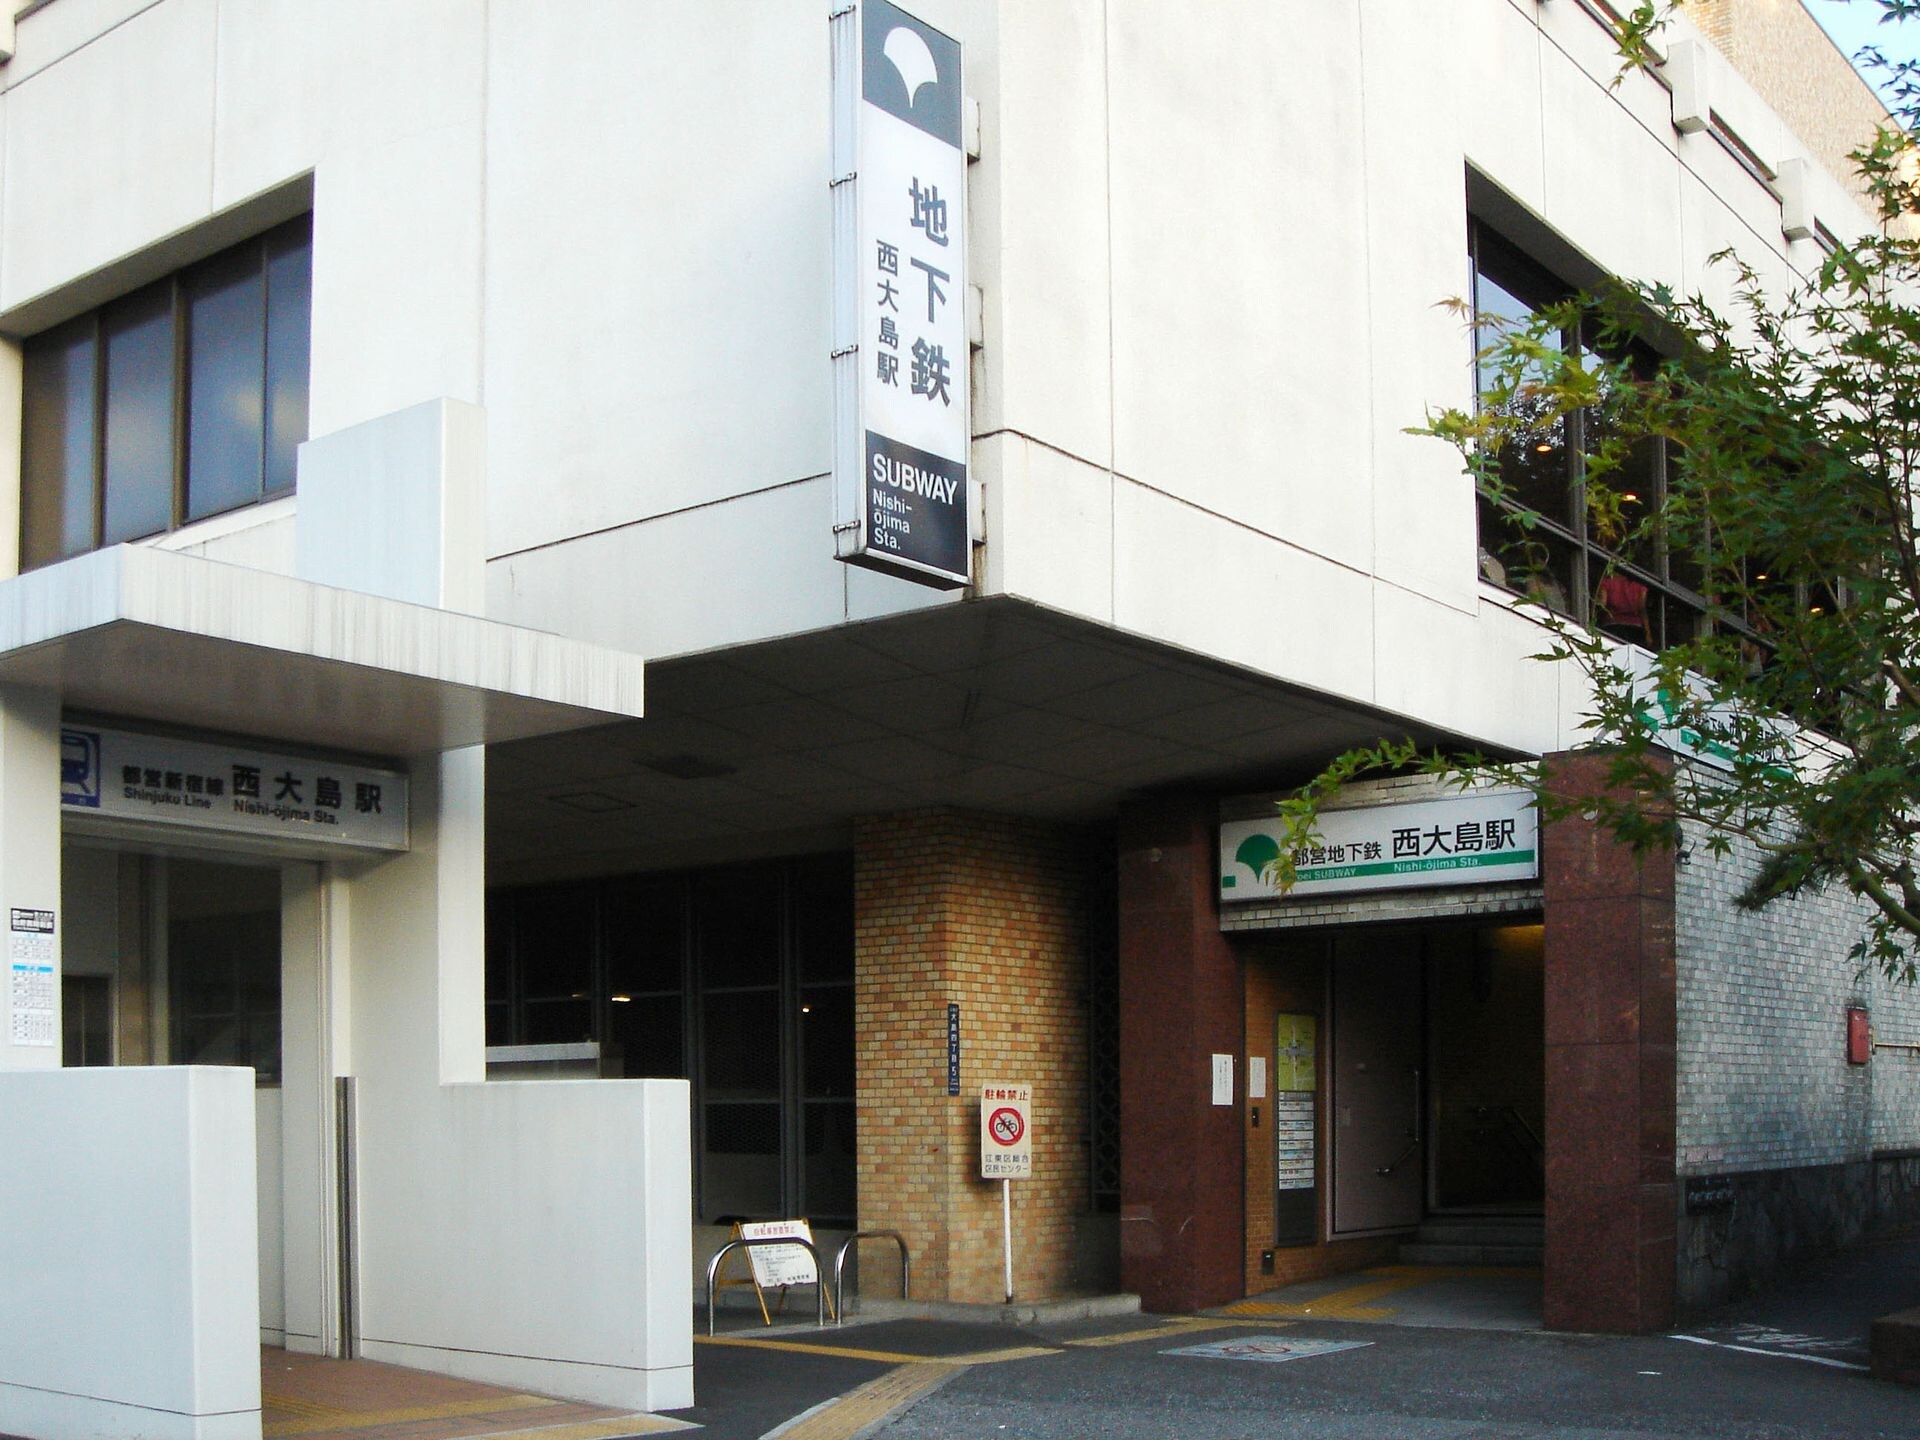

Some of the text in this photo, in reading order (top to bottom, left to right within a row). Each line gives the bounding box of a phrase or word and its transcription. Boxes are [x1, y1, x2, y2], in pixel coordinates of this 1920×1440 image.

[908, 176, 950, 407] 地下鉄
[876, 239, 899, 387] 西大島駅
[873, 453, 958, 505] SUBWAY
[873, 488, 912, 517] Nishi-
[874, 529, 901, 550] Sta.
[124, 786, 181, 806] Shinjuku
[185, 793, 212, 809] Line
[314, 809, 339, 825] Sta.
[231, 764, 382, 814] 西大島駅
[1392, 818, 1515, 859] 西大島駅
[1314, 868, 1357, 880] SUBWAY
[1460, 857, 1481, 868] Sta.
